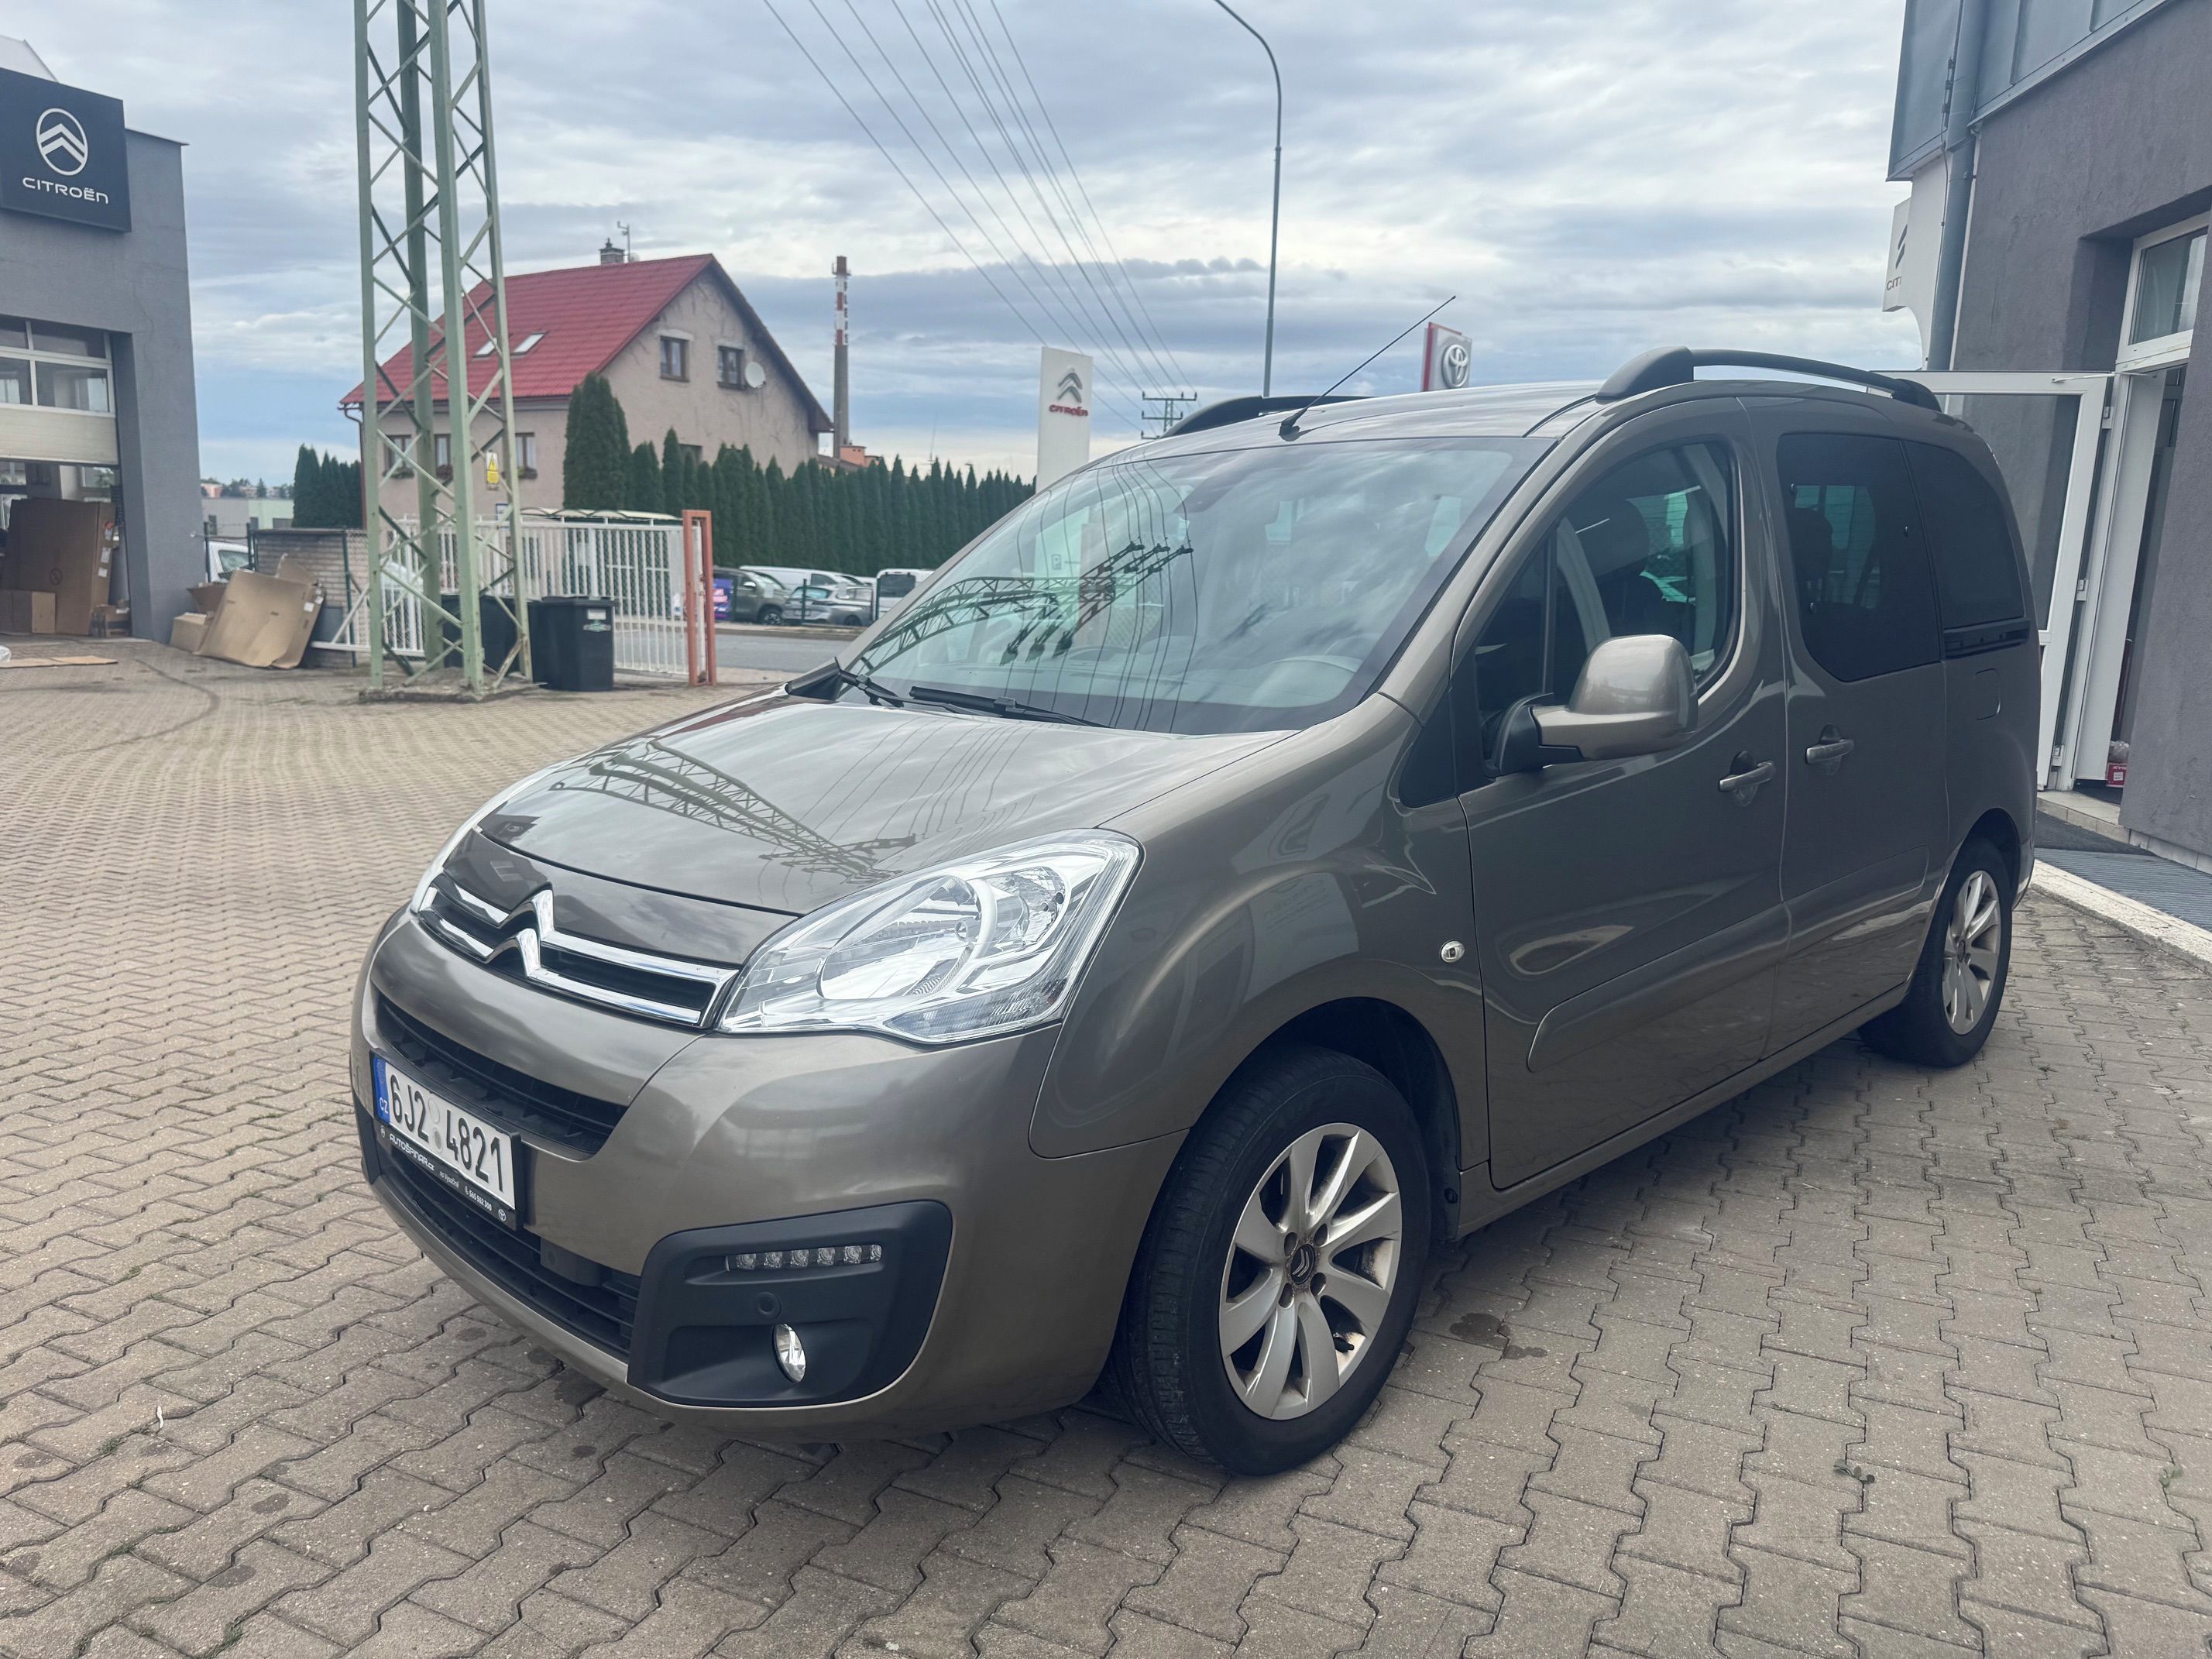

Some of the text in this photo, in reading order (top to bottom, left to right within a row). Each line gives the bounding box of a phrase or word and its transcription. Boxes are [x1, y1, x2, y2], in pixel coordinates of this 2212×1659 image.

[22, 177, 109, 204] CITROËN
[380, 1097, 389, 1114] CZ
[390, 1074, 503, 1192] 6J2 4821
